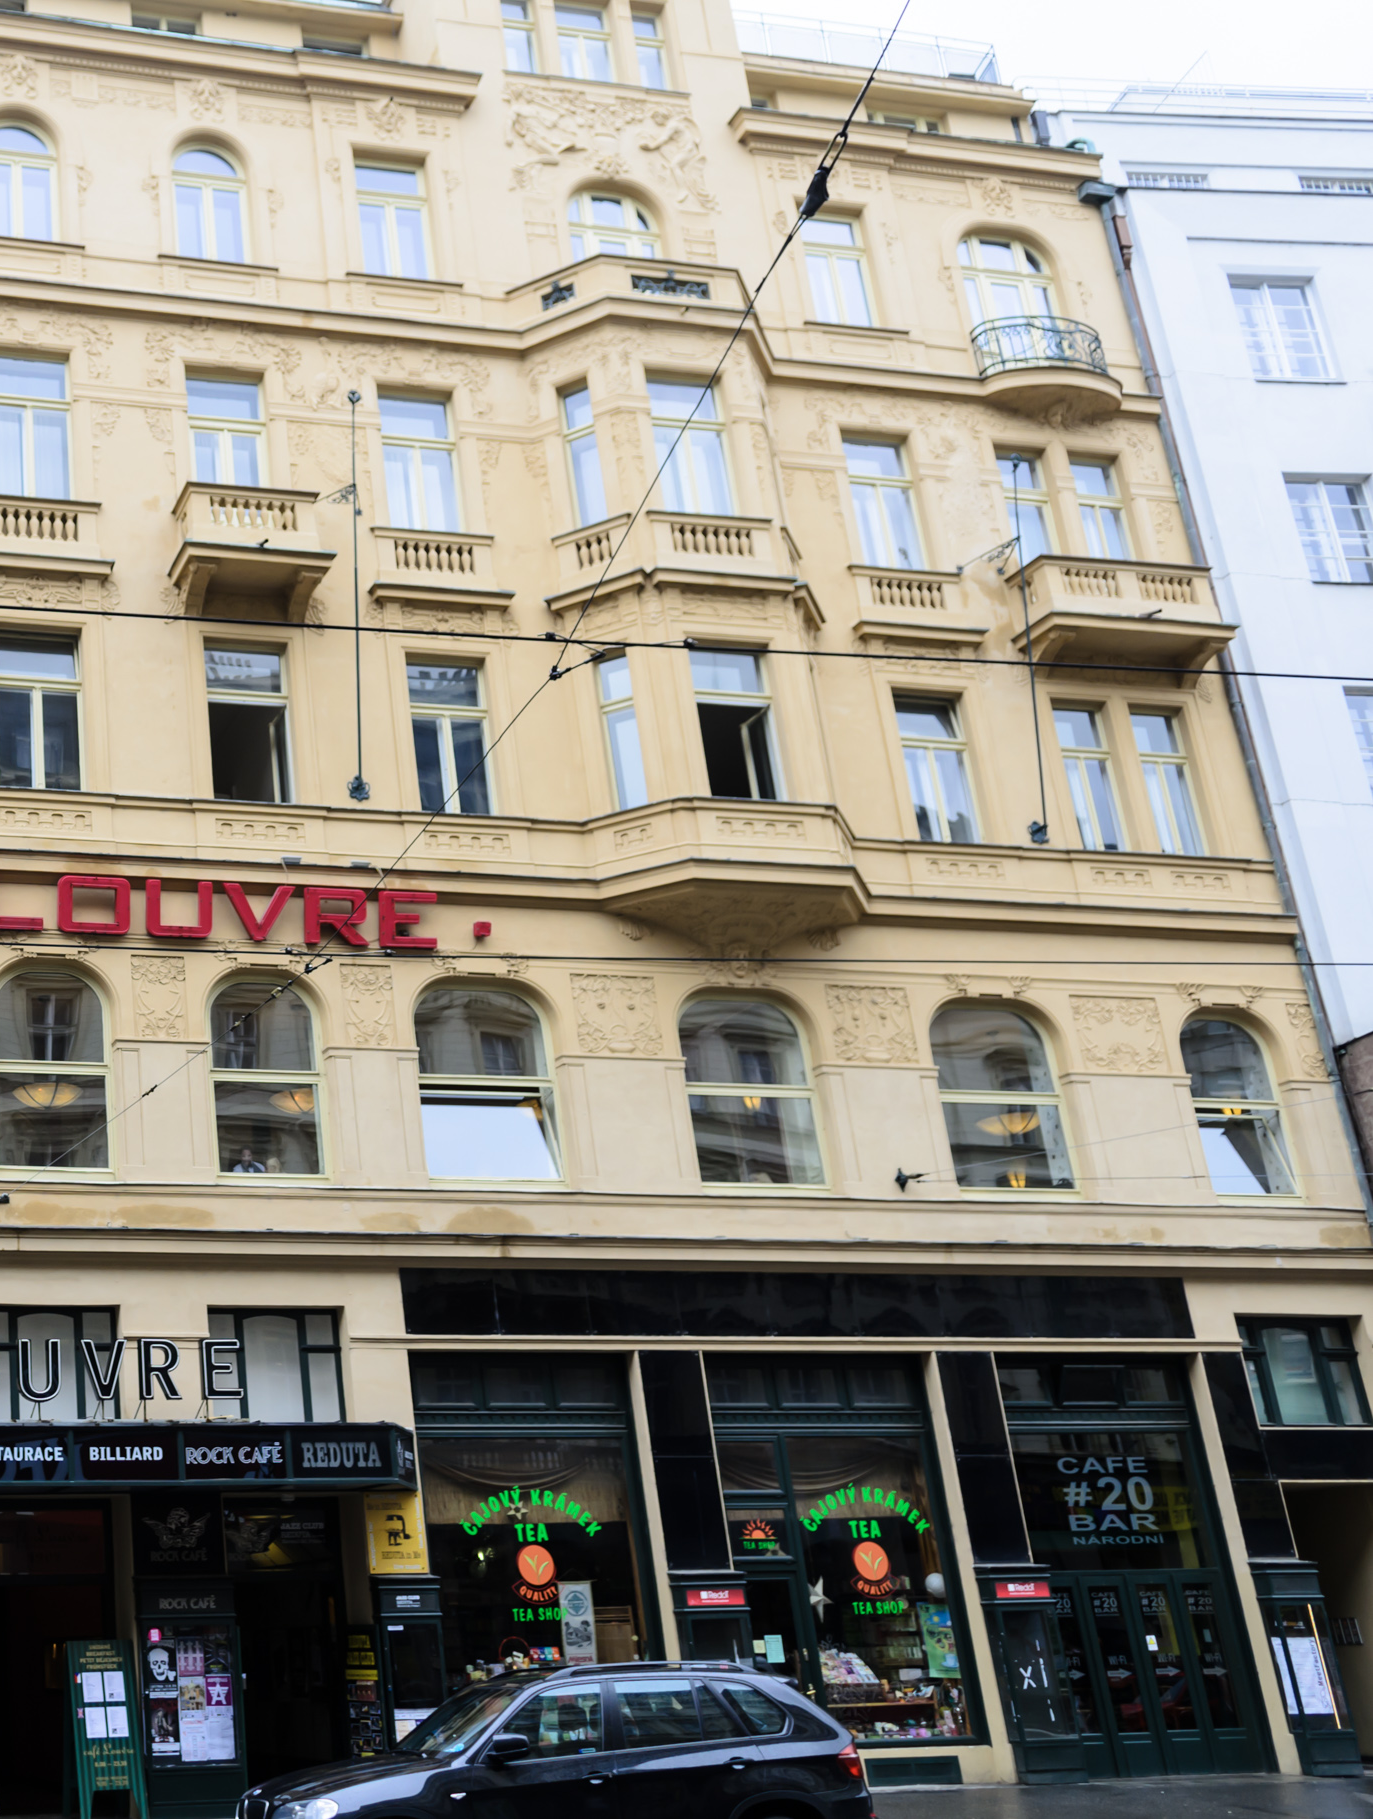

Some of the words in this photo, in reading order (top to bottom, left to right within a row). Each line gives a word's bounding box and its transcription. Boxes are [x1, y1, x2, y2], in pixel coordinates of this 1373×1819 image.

[89, 1446, 164, 1461] BILLIARD
[185, 1446, 235, 1465] ROCK
[238, 1441, 284, 1464] CAFÉ
[301, 1442, 382, 1468] REDUTA
[1056, 1457, 1149, 1474] CAFE
[1063, 1476, 1154, 1511] #20
[459, 1486, 521, 1536] ČAJOVÝ
[530, 1489, 602, 1537] KRÁMEK
[799, 1482, 856, 1532] ČAJOVÝ
[861, 1486, 930, 1534] KRÁMEK
[848, 1520, 882, 1538] TEA
[1068, 1513, 1160, 1531] BAR
[514, 1523, 549, 1542] TEA
[1072, 1533, 1164, 1545] NÁRODNÍ
[150, 1550, 178, 1562] ROCK
[519, 1585, 558, 1601] QUALITY
[857, 1580, 893, 1596] QUALITY
[159, 1598, 187, 1610] ROCK
[189, 1595, 217, 1609] CAFÉ
[852, 1602, 874, 1615] TEA
[876, 1601, 905, 1614] SHOP
[1093, 1597, 1118, 1608] #20
[1141, 1596, 1166, 1607] #20
[512, 1608, 534, 1622] TEA
[538, 1607, 568, 1621] SHOP
